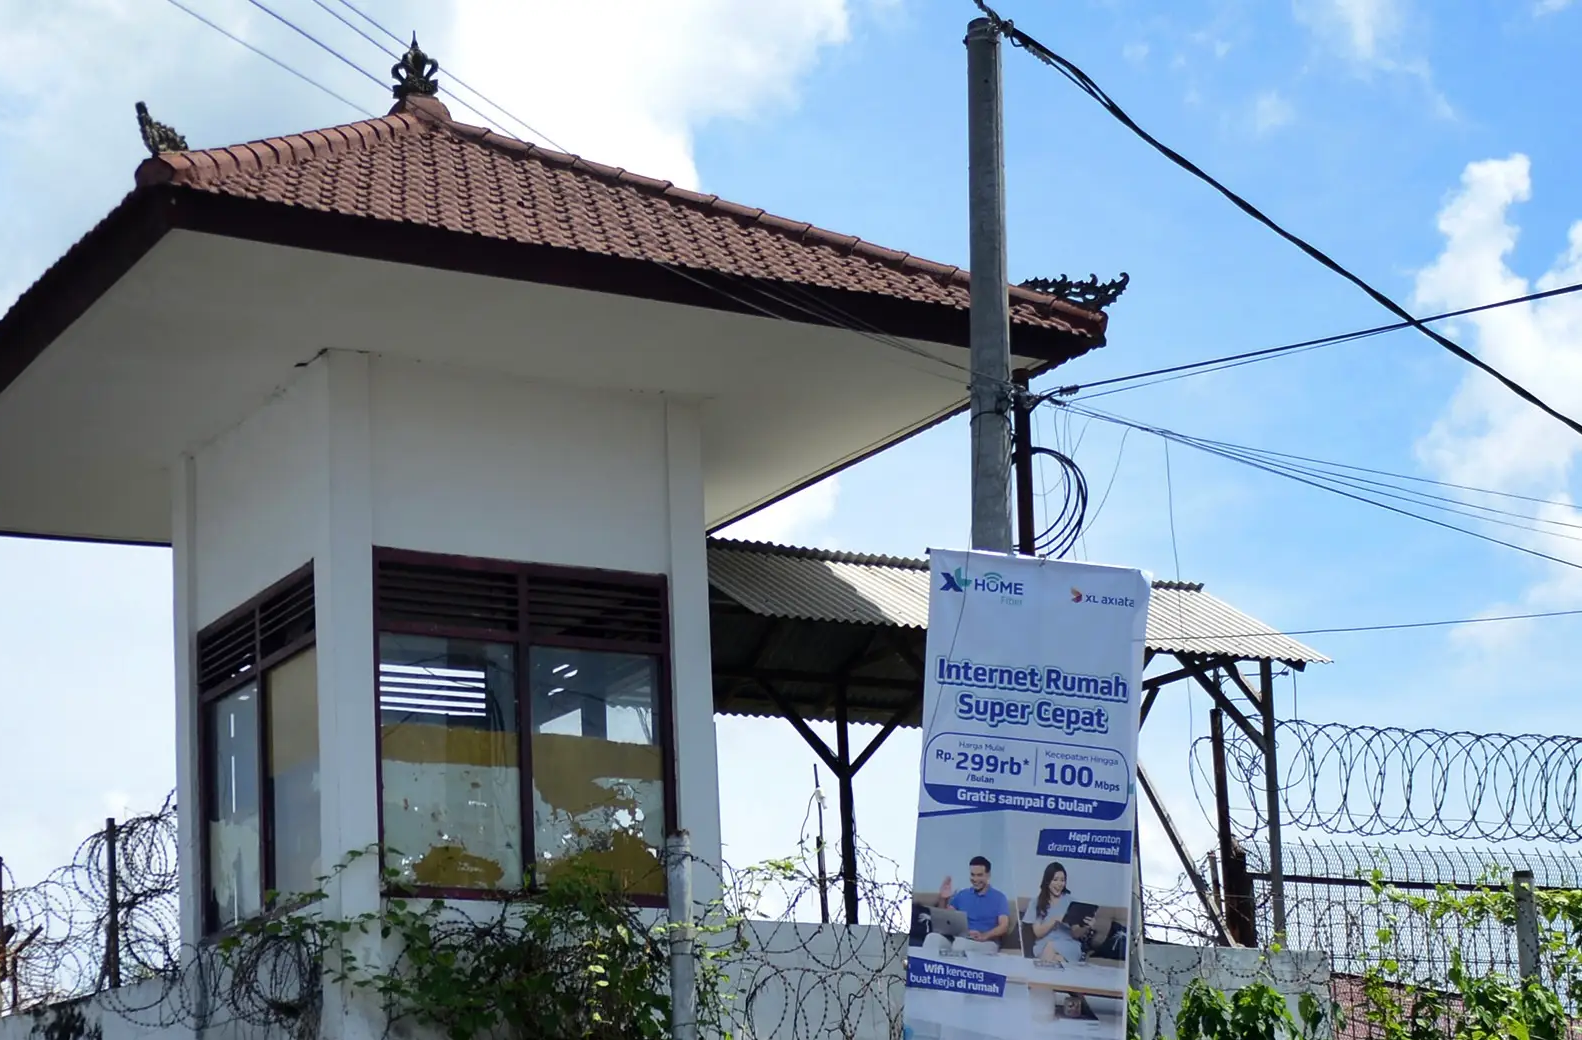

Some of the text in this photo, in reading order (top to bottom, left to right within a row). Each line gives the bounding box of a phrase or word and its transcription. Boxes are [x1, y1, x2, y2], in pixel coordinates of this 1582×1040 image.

[974, 578, 1024, 595] HOME
[1085, 594, 1135, 608] XL axiata
[937, 658, 1128, 699] Internet Rumah
[958, 693, 1106, 732] Super Cepat
[936, 749, 955, 762] Rp.
[1045, 750, 1119, 766] Kecepatan Hingga
[1044, 762, 1120, 792] 100 Mbps
[957, 788, 996, 803] Gratis
[998, 794, 1044, 809] sampai
[1046, 797, 1056, 809] 6
[1068, 831, 1121, 844] Hepi nonton
[1047, 842, 1120, 856] drama di rumah!
[923, 963, 985, 982] Wifi kenceng
[909, 973, 1000, 994] buat kerja di rumah
